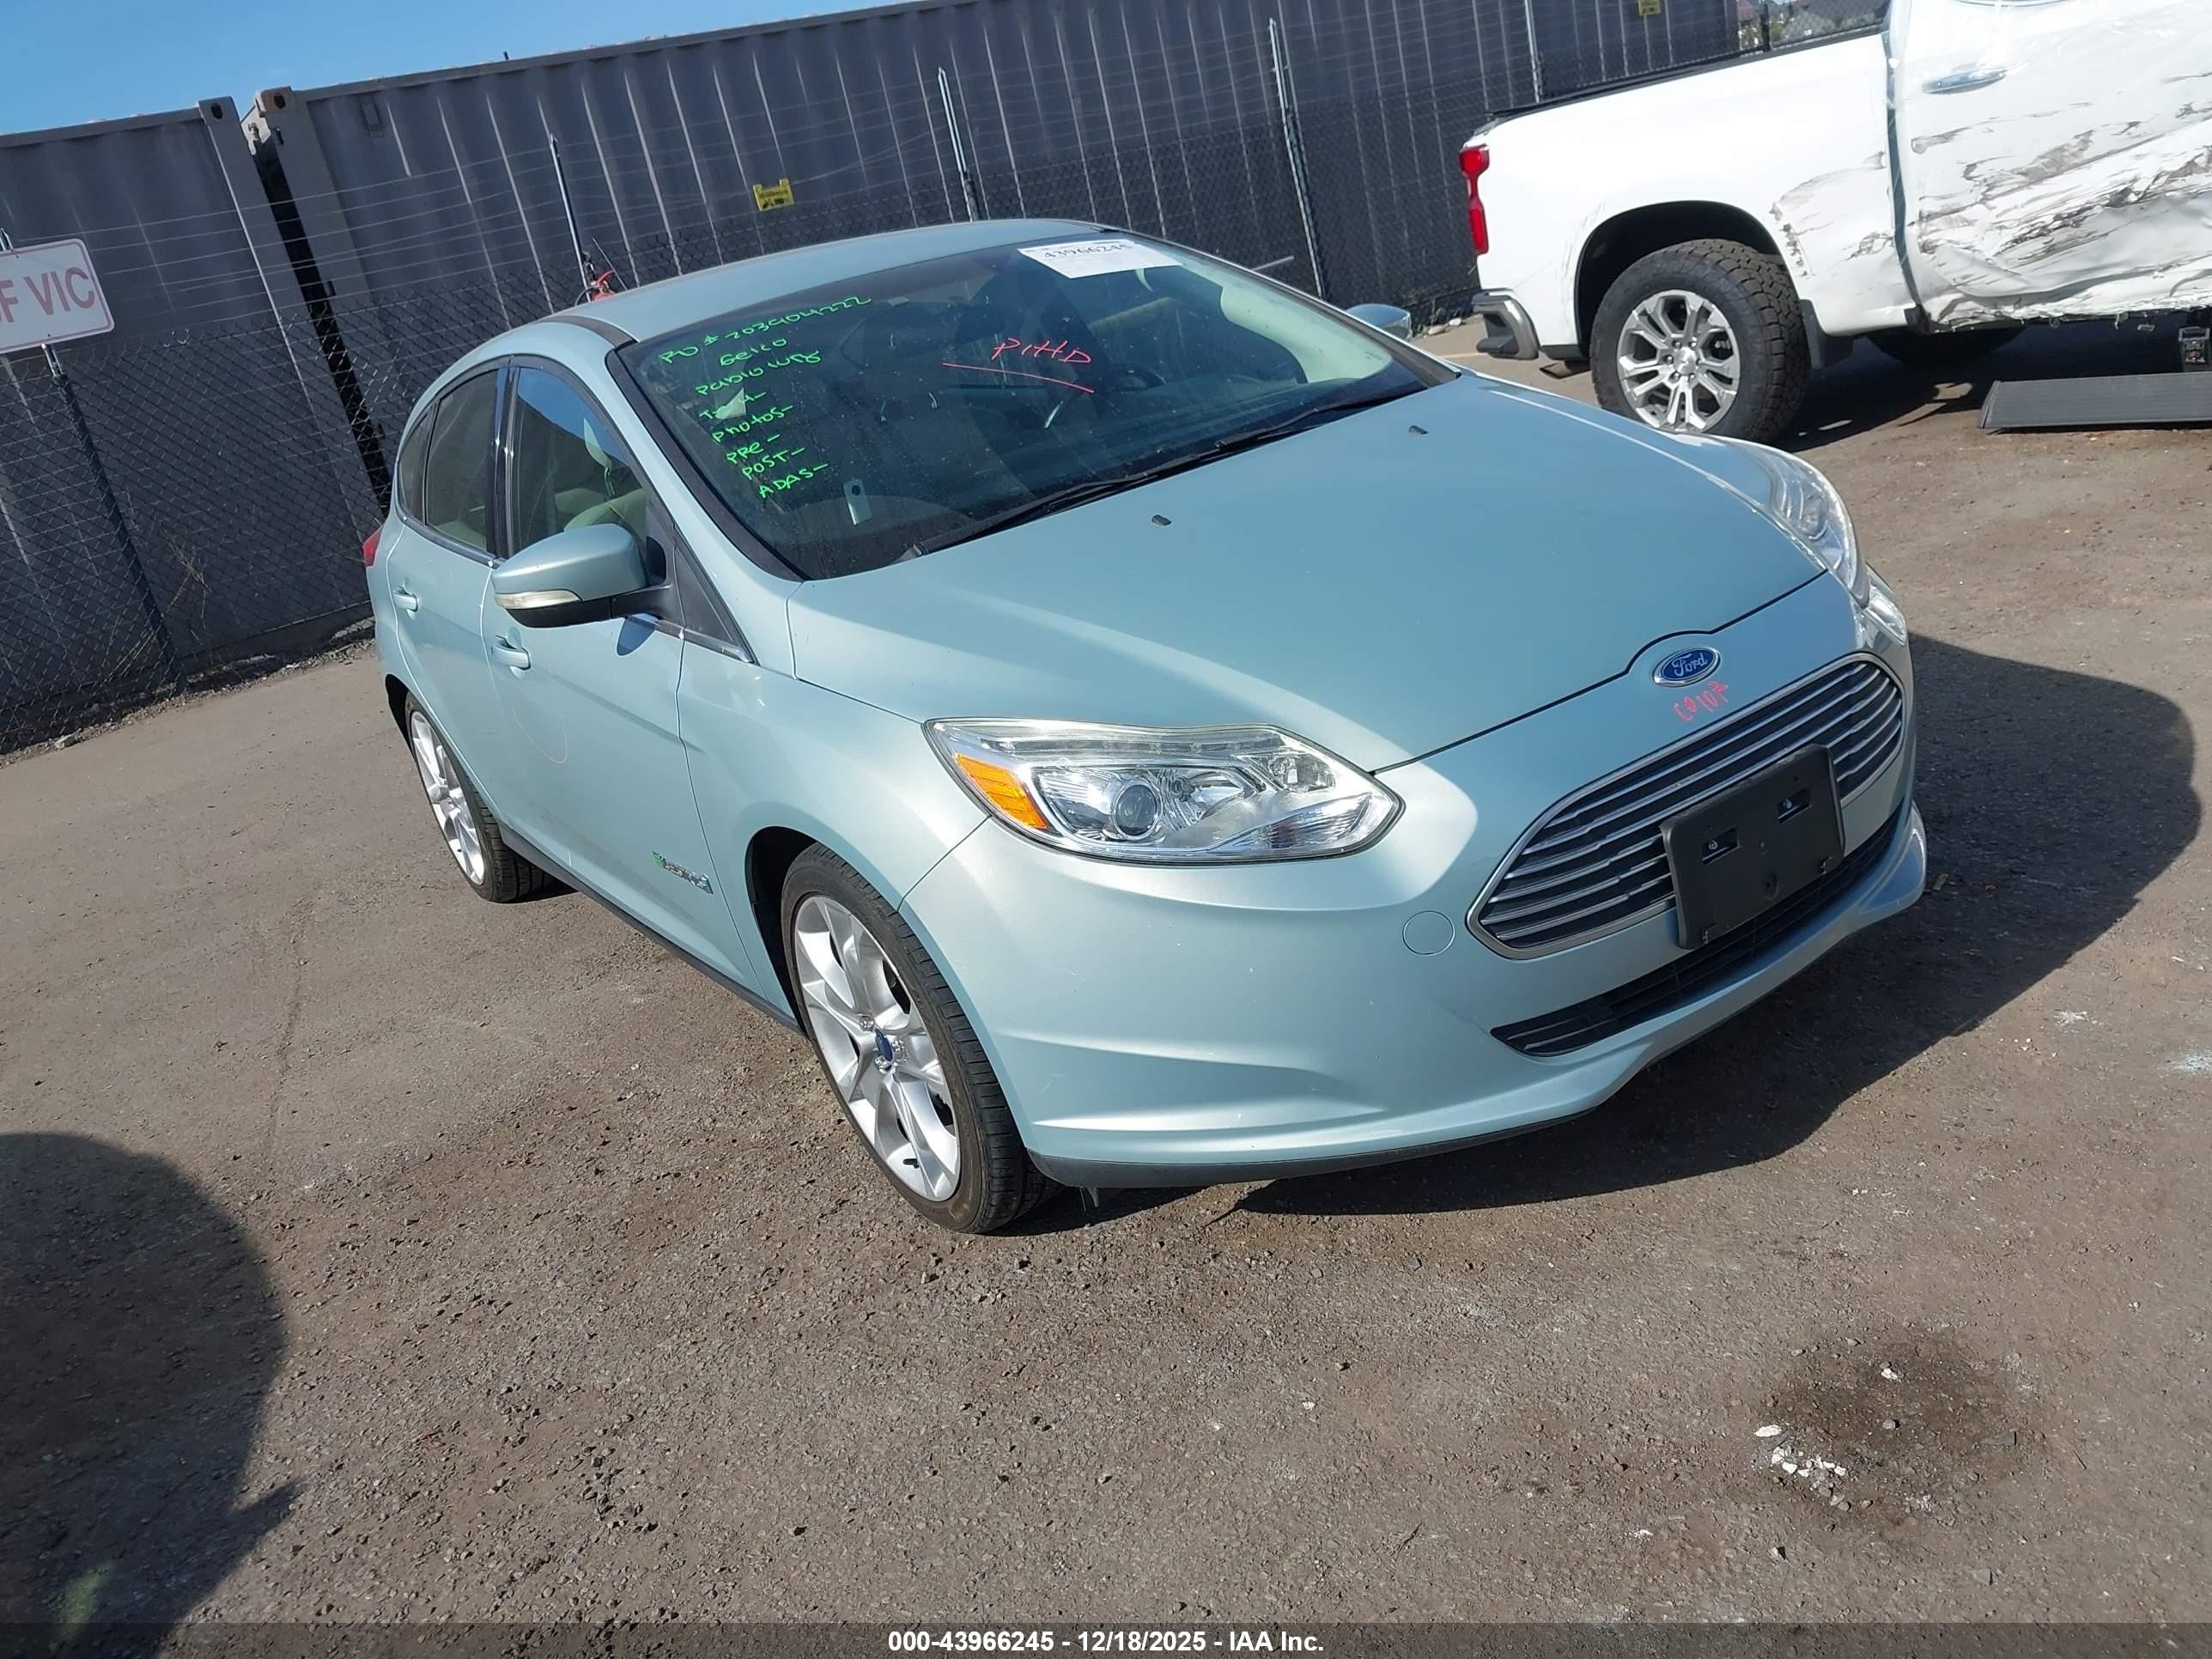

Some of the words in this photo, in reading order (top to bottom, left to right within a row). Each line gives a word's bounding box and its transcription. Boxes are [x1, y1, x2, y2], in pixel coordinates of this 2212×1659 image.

[1044, 244, 1133, 259] 43966245
[23, 267, 94, 315] VIC
[659, 346, 699, 363] PO
[1672, 653, 1708, 677] Ford
